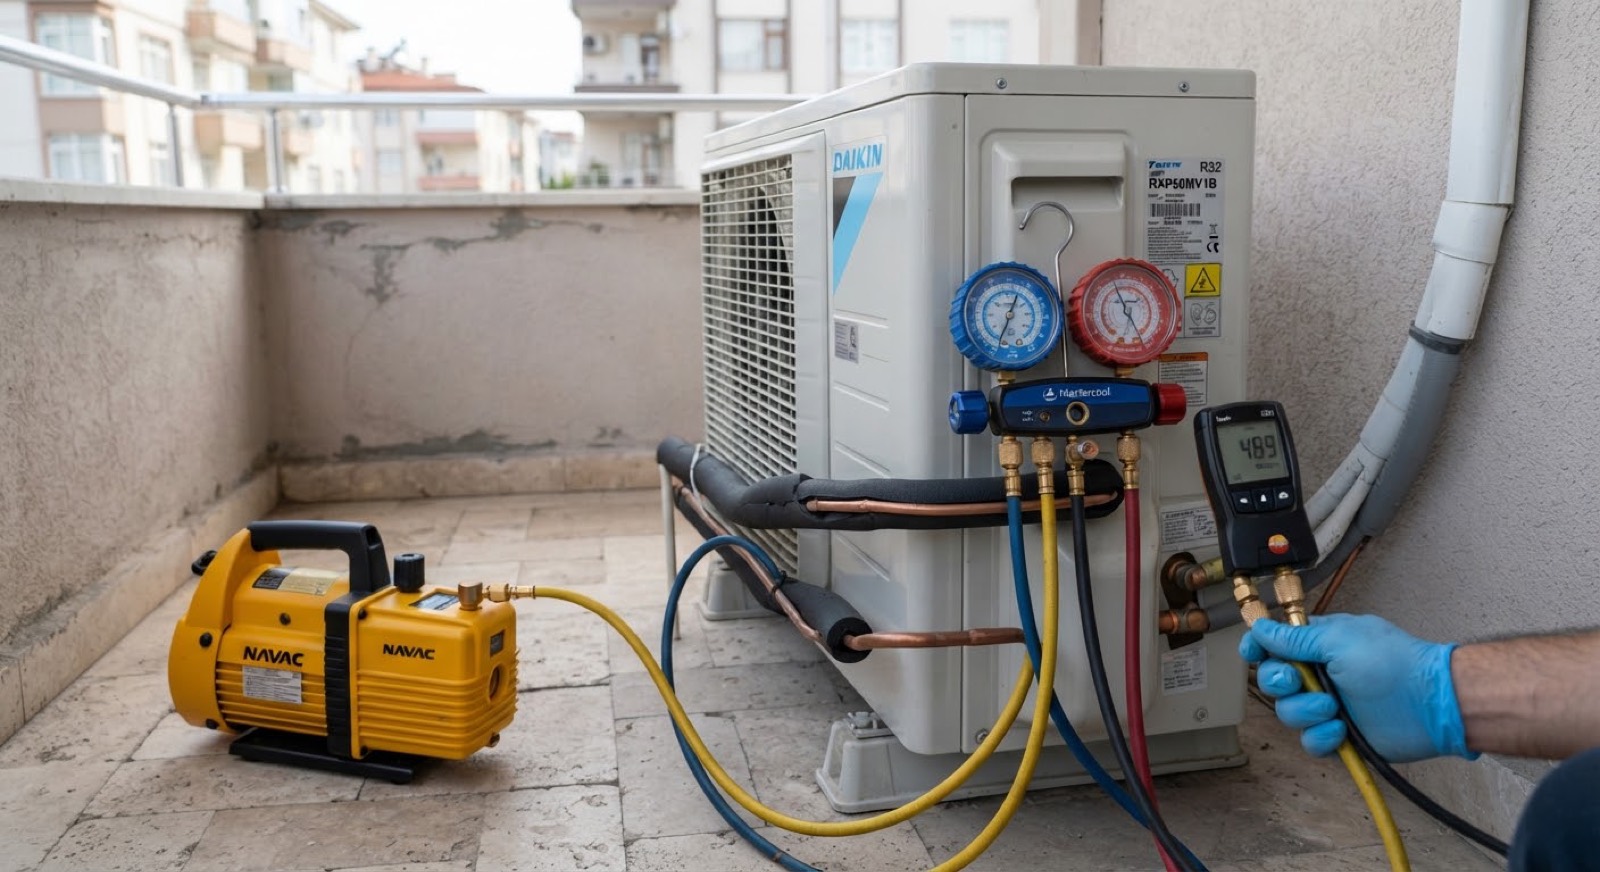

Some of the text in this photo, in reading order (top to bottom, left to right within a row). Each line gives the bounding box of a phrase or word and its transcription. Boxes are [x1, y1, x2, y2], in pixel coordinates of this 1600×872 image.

[833, 143, 883, 172] DAIKIN
[1200, 161, 1222, 173] R32
[1240, 435, 1277, 460] 489
[243, 646, 304, 667] NAVAC
[383, 643, 436, 660] NAVAC
